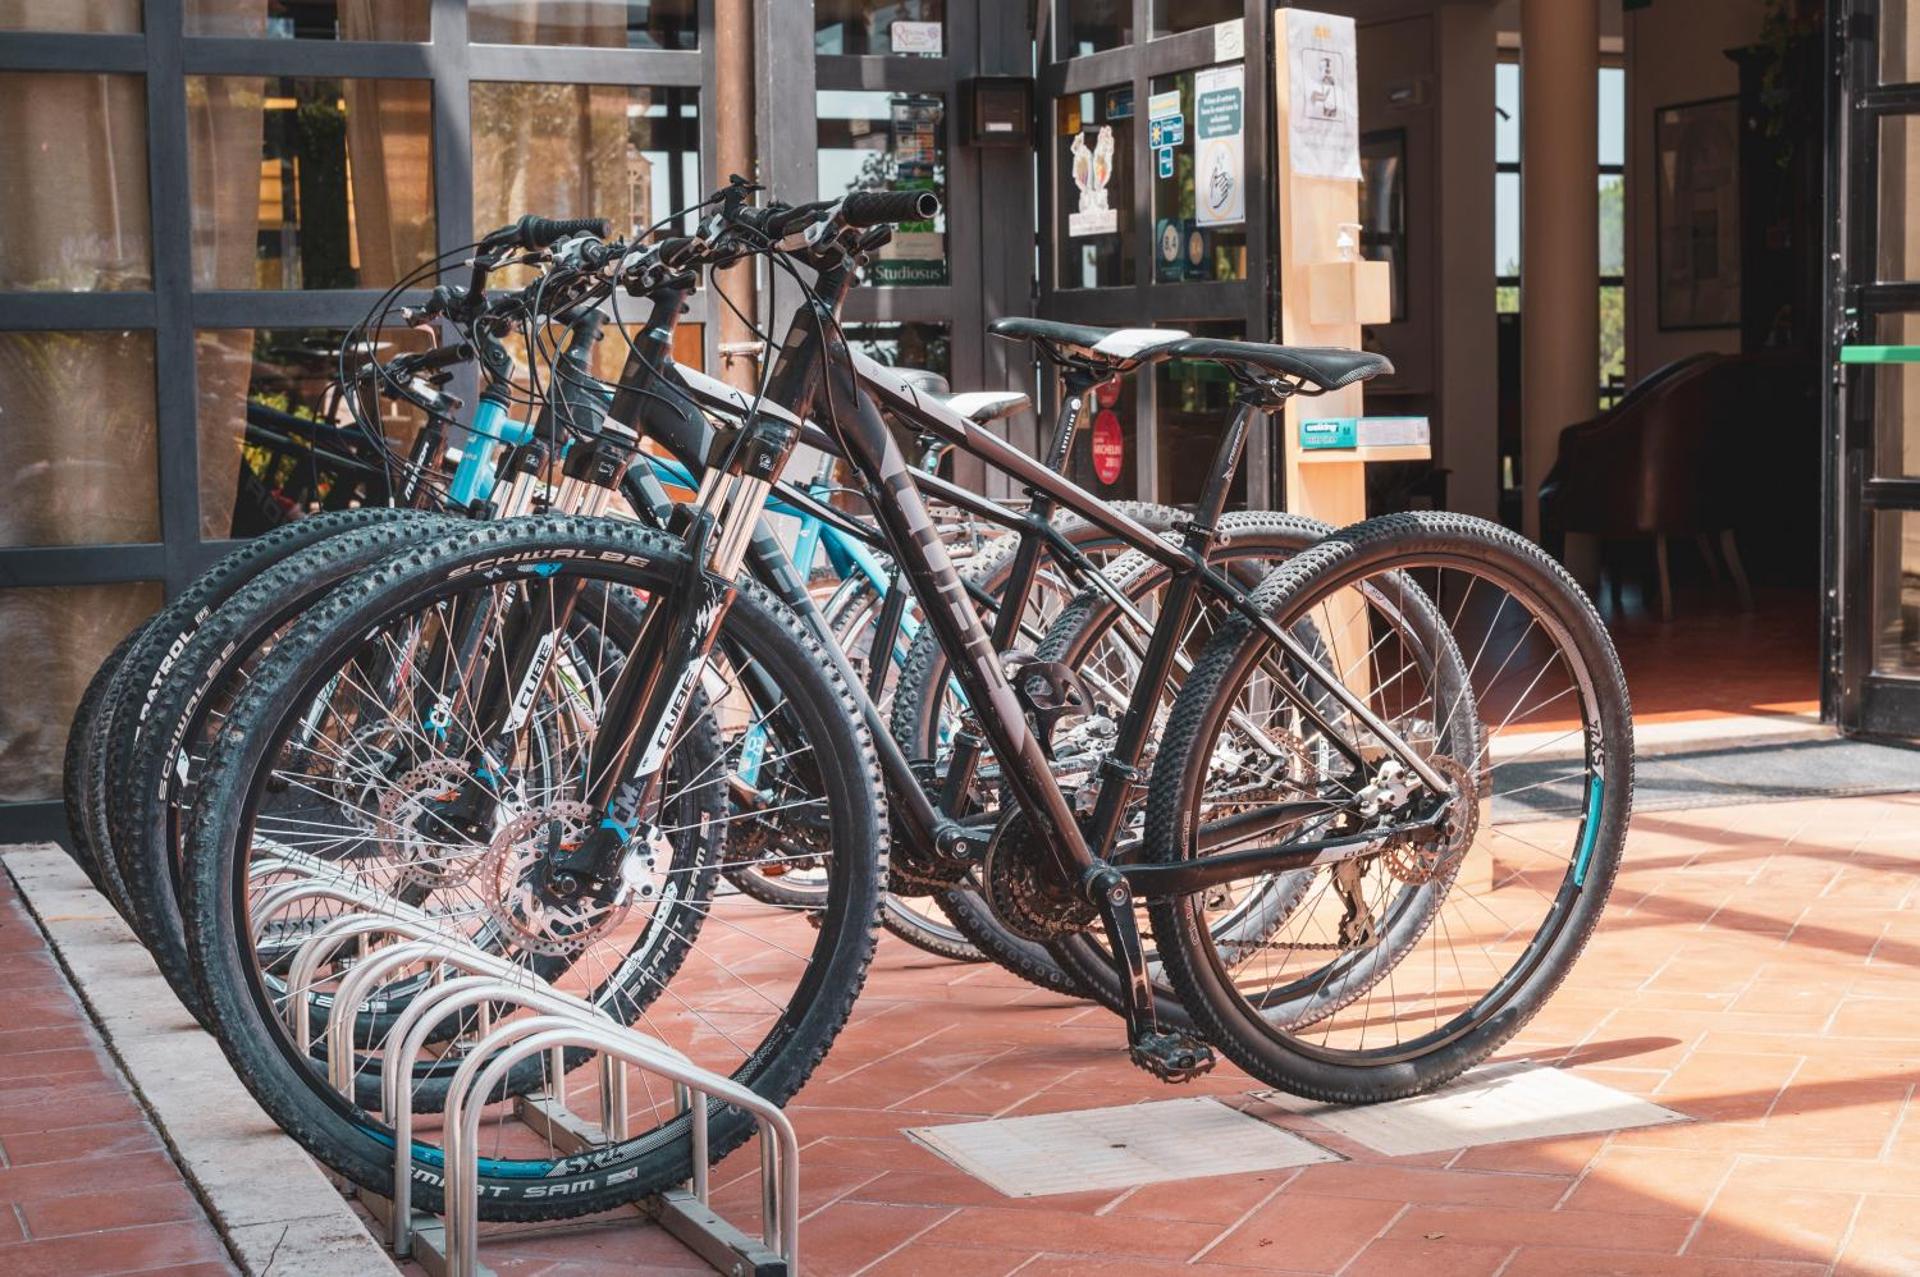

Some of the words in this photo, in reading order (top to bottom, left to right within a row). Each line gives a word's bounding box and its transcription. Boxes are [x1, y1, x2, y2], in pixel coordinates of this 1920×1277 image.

[875, 265, 941, 280] Studiosus
[446, 547, 652, 581] SCHWALBE
[519, 642, 553, 710] CUBE
[657, 667, 696, 750] CUBE
[626, 914, 685, 999] SMART
[685, 847, 707, 906] SAM
[523, 1179, 596, 1199] SAM
